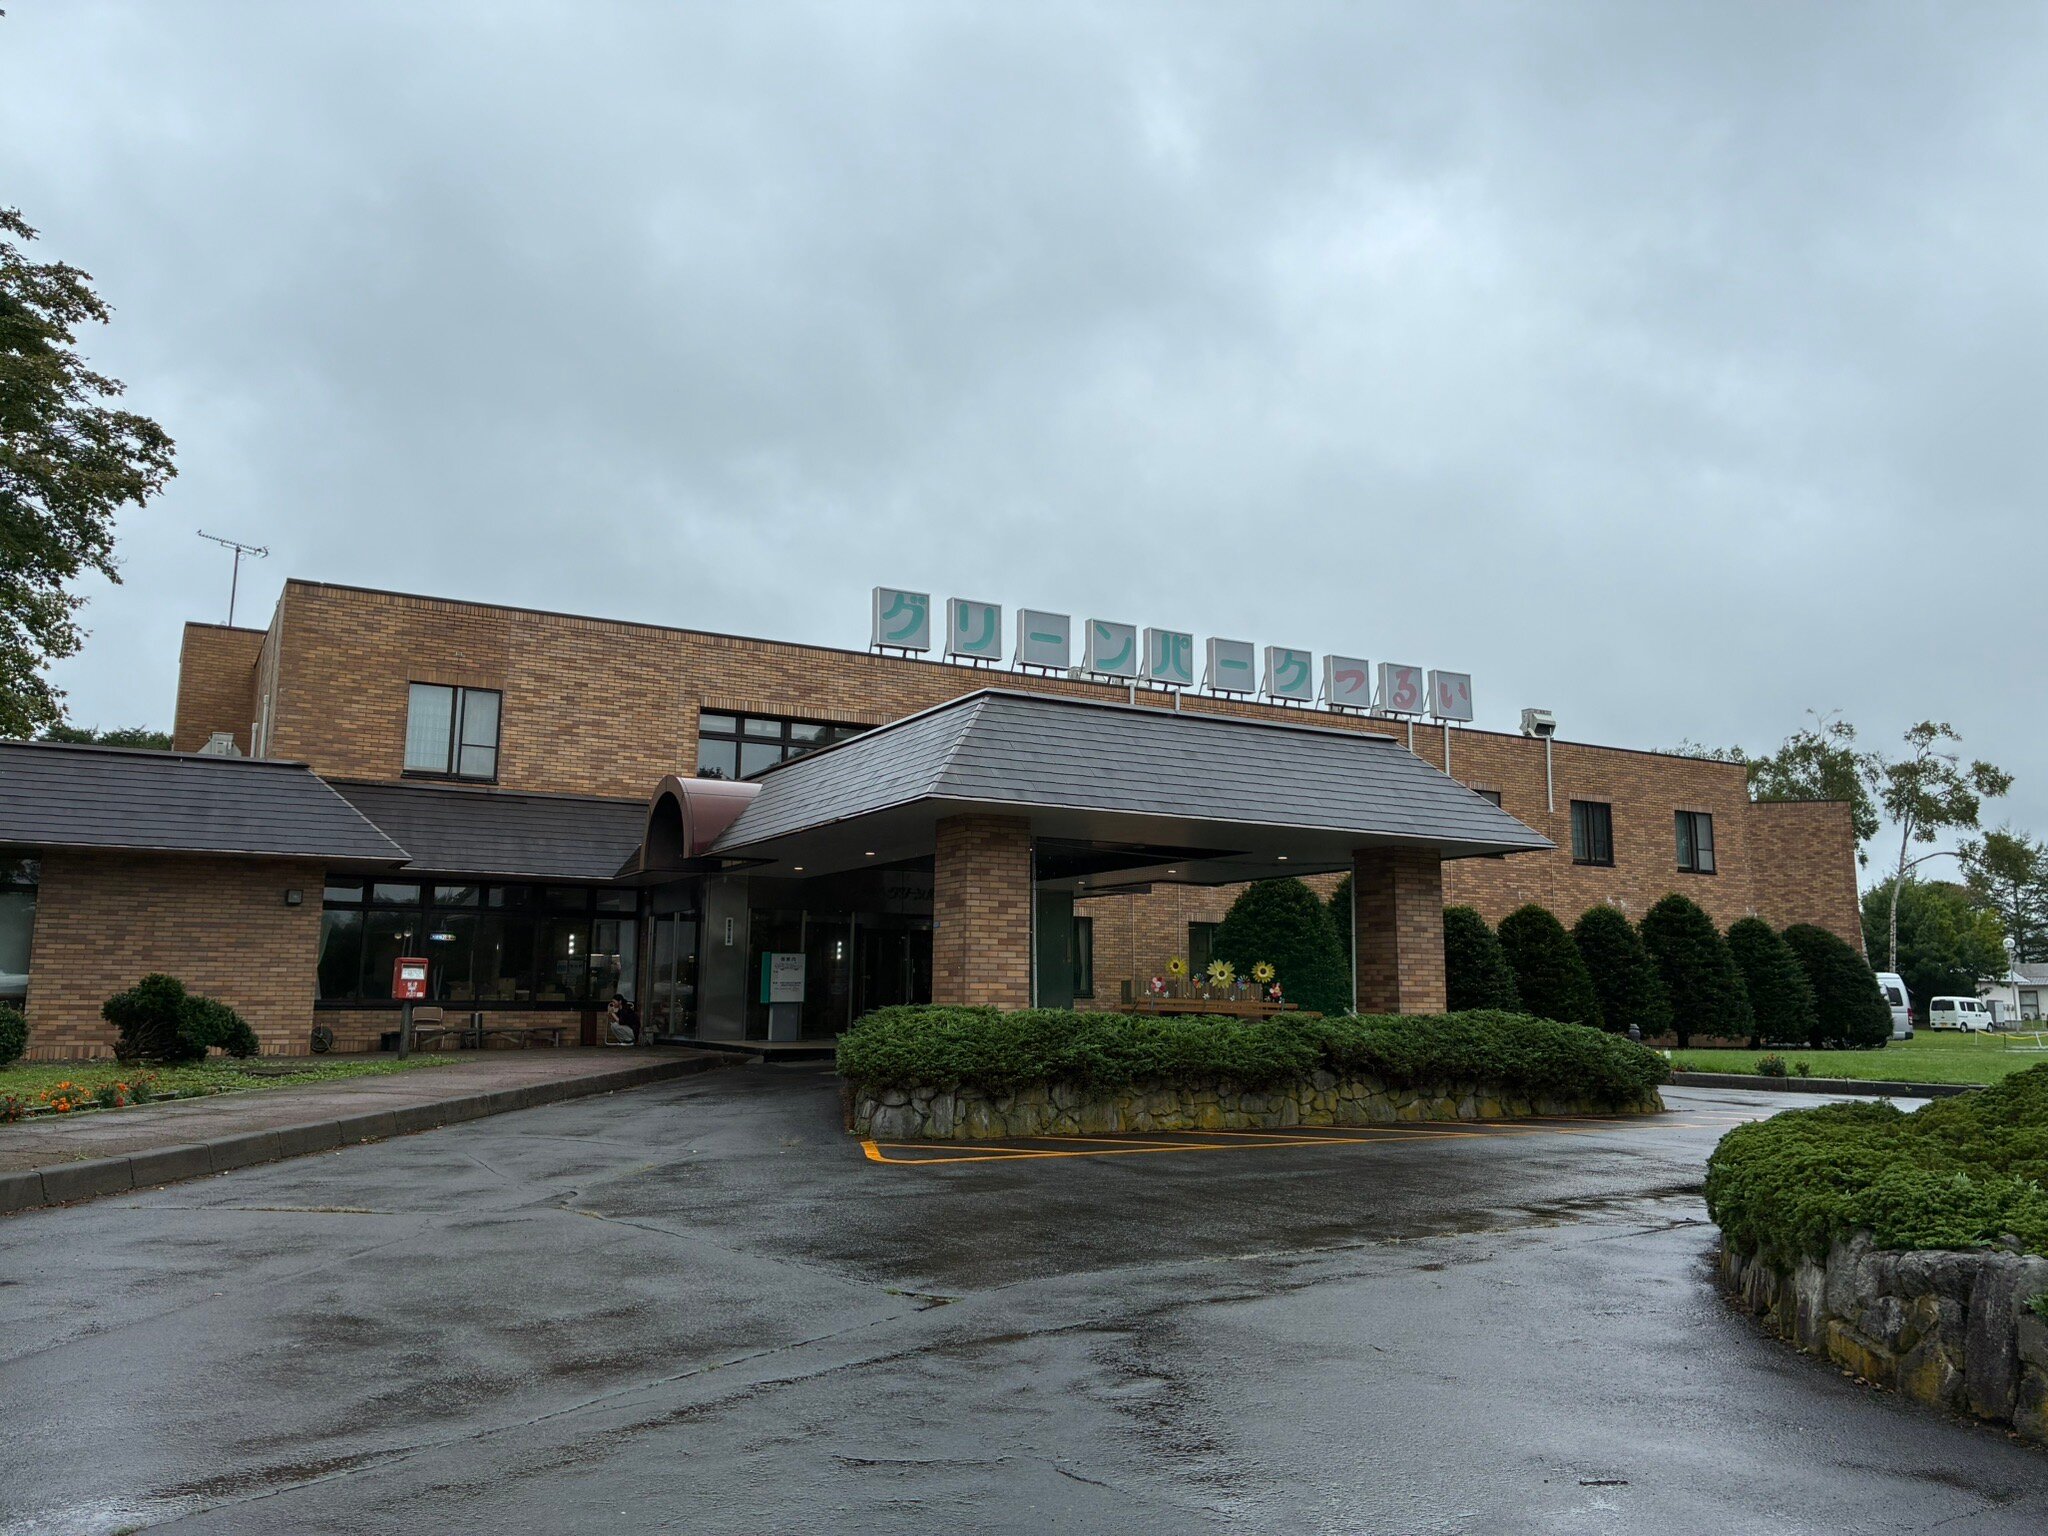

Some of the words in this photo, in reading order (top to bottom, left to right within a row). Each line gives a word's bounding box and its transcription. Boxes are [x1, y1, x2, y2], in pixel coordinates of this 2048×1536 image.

[882, 592, 1469, 709] グリーンパークつるい
